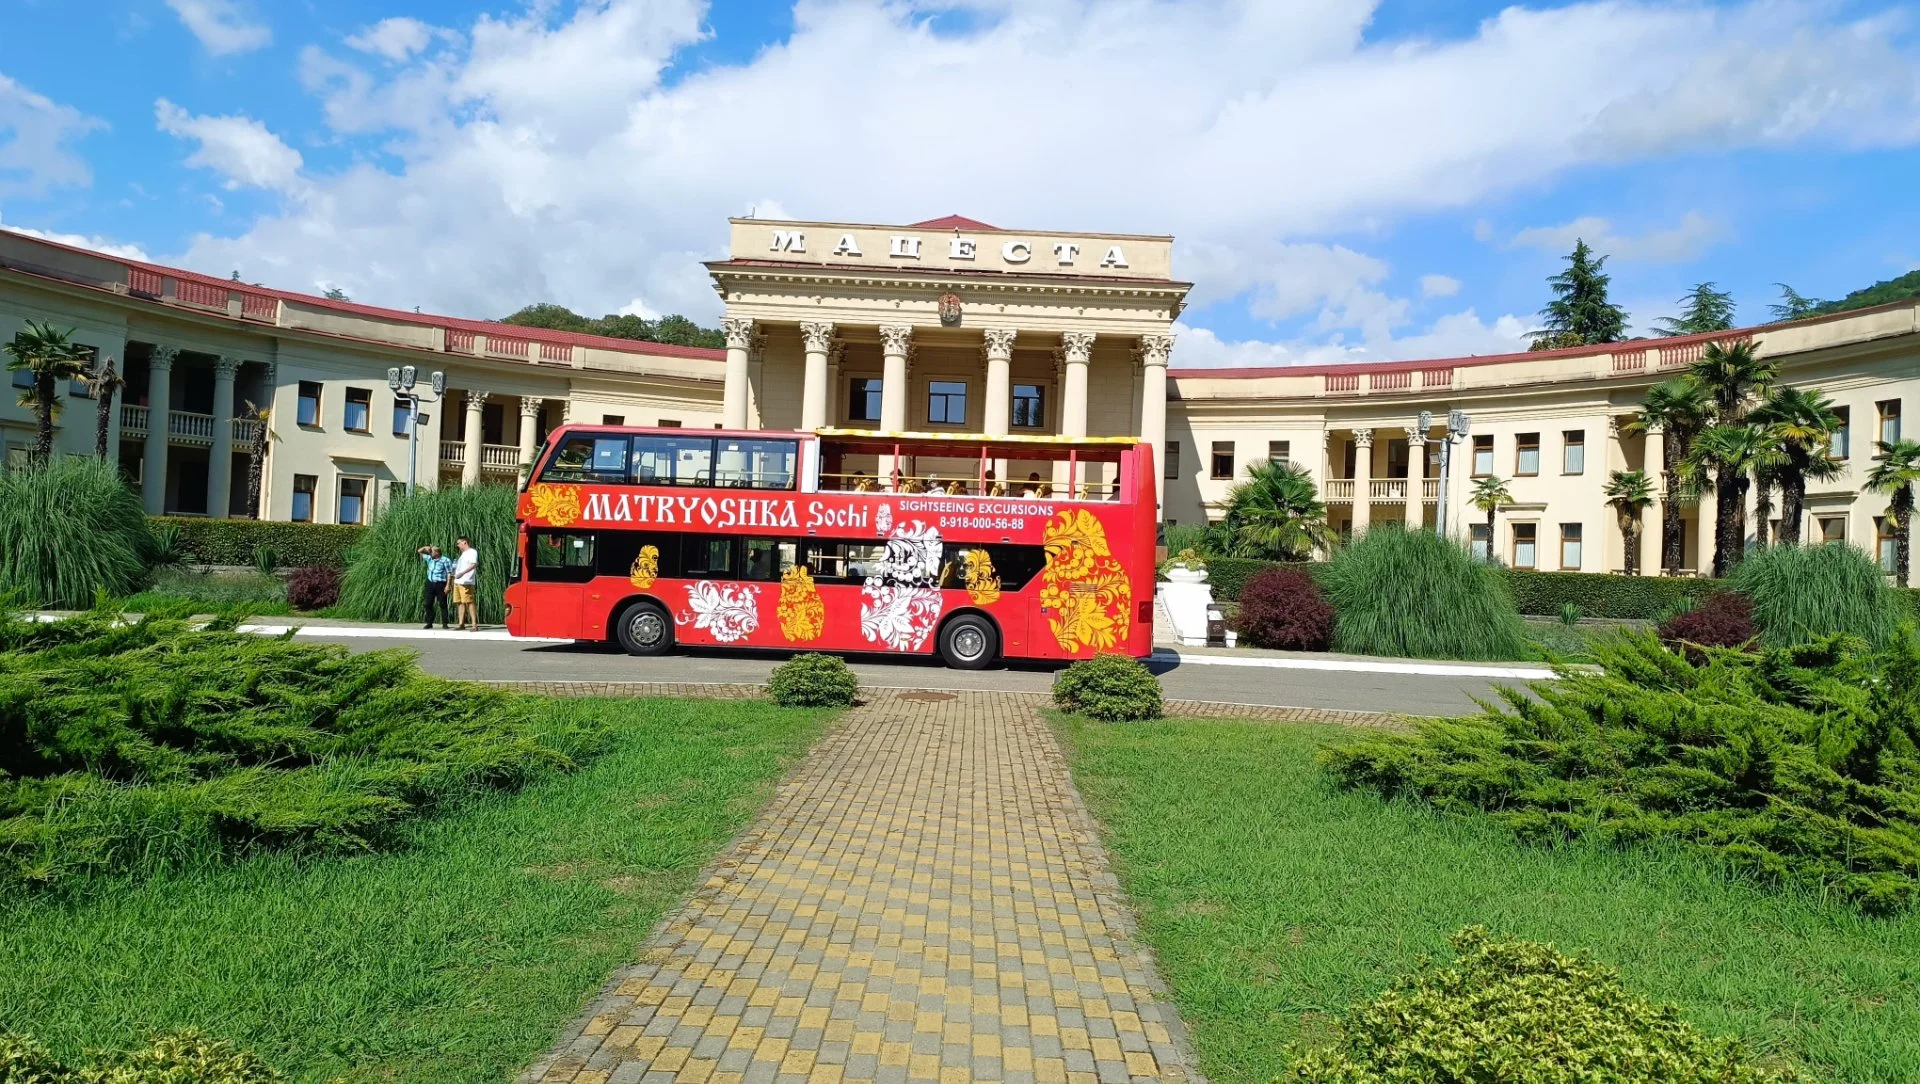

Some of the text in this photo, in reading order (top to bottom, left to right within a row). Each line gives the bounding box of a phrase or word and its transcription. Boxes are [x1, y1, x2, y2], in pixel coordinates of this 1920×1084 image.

[769, 230, 1129, 267] МАЦЕСТА
[583, 493, 867, 528] MATRYOSHKA Sochi
[899, 500, 1054, 516] SIGHTSEEING EXCURSIONS
[939, 516, 1024, 530] 8-918-000-56-88
